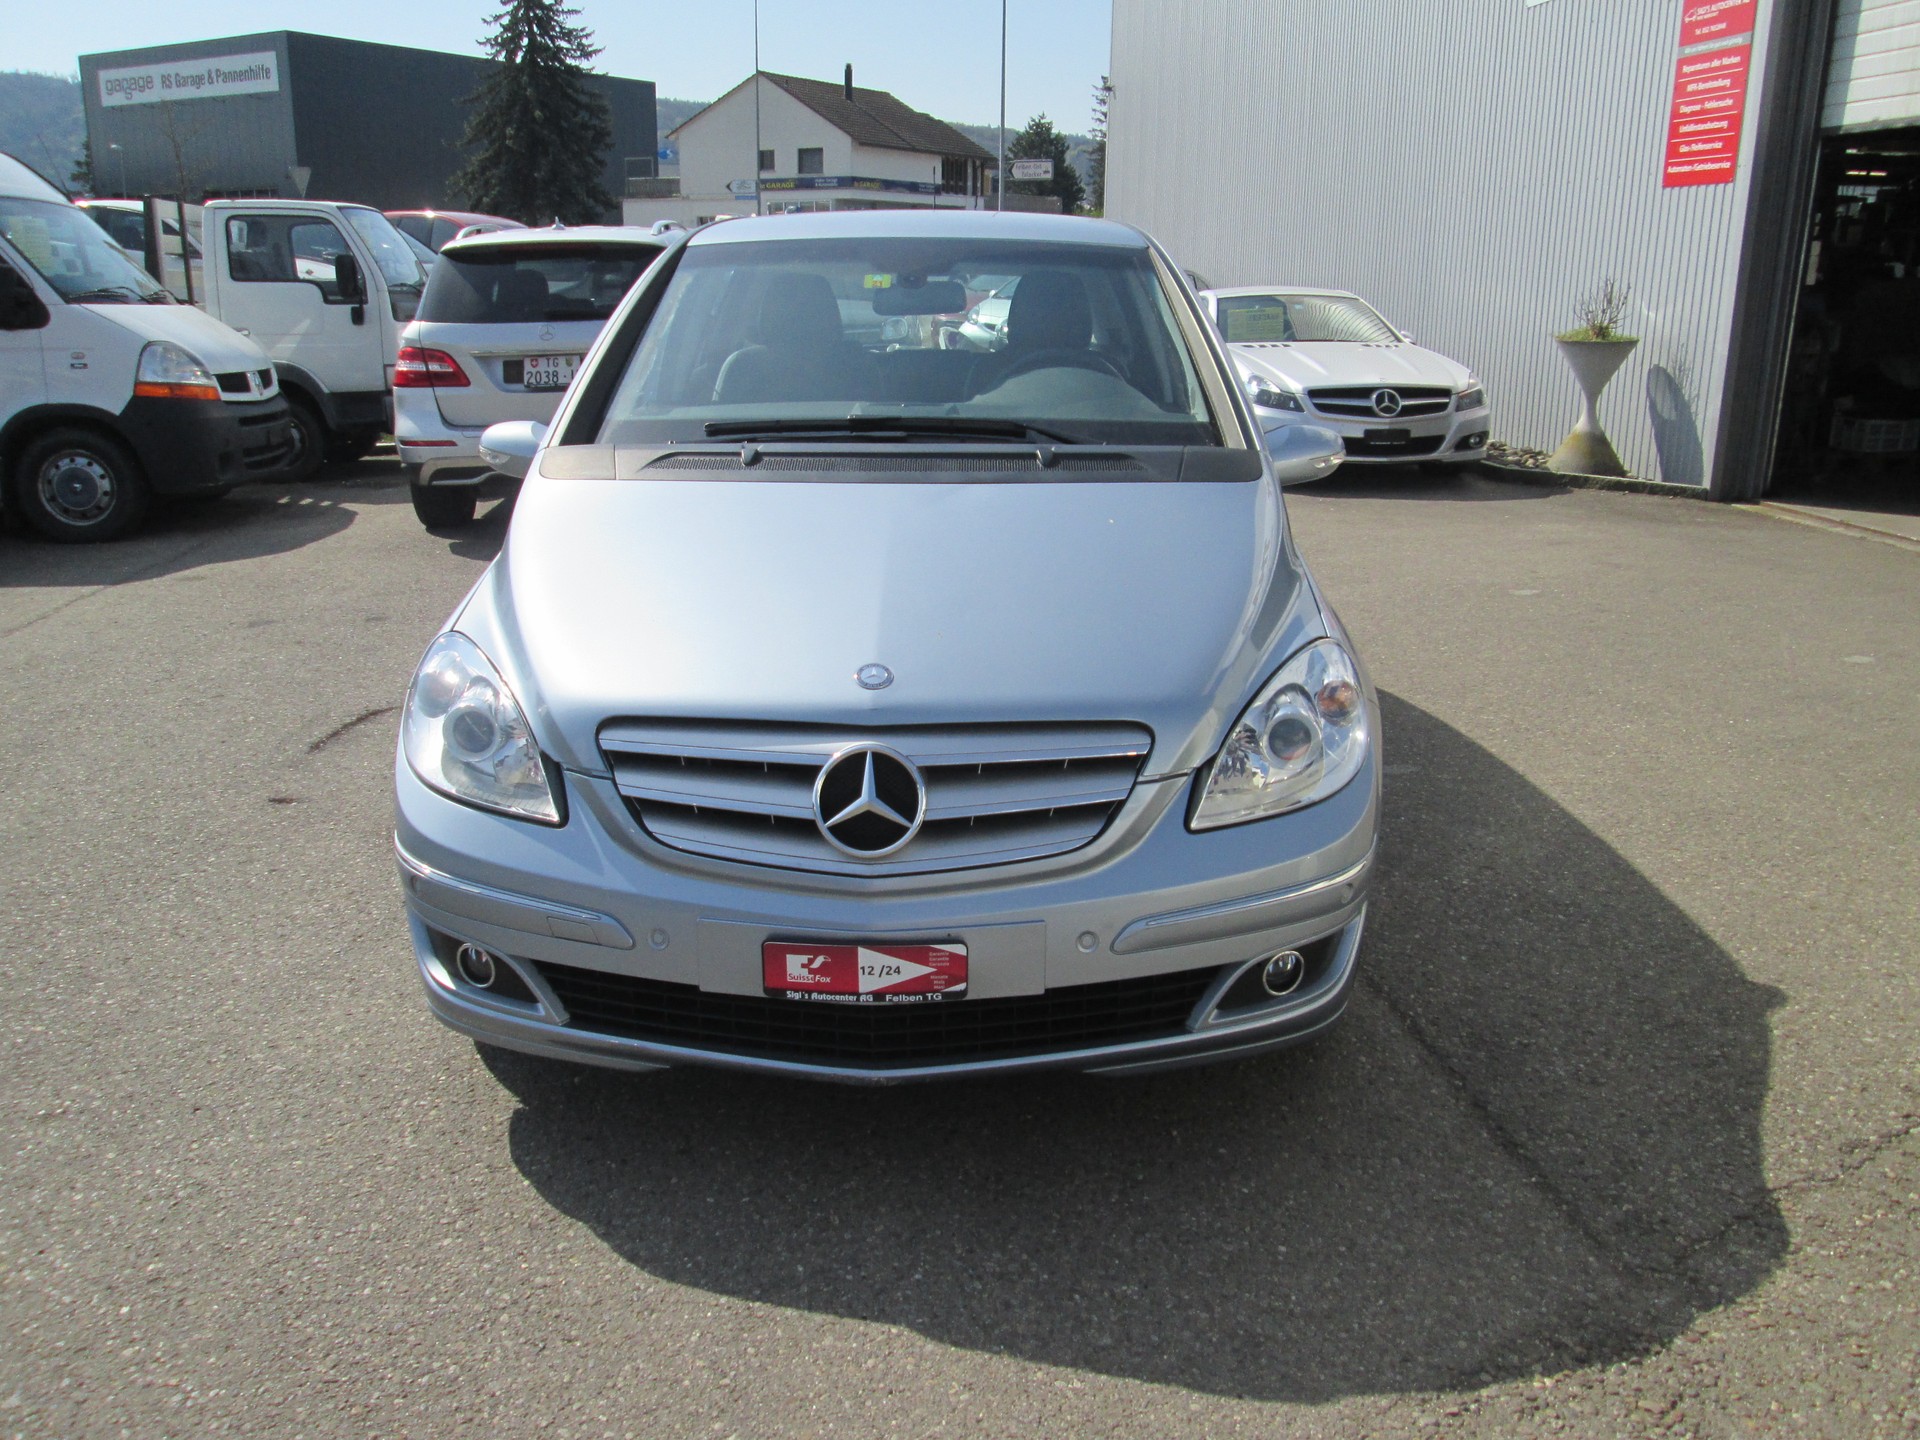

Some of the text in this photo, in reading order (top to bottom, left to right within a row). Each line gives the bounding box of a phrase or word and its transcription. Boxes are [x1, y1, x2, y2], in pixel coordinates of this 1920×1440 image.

[160, 64, 271, 90] RS Garage & Pannenhilfe
[545, 357, 559, 368] TG
[526, 370, 559, 386] 2038
[860, 965, 875, 976] 12
[815, 974, 831, 983] Fox
[811, 992, 857, 1002] Autocenter
[860, 994, 873, 1002] AG
[926, 992, 942, 1001] TG
